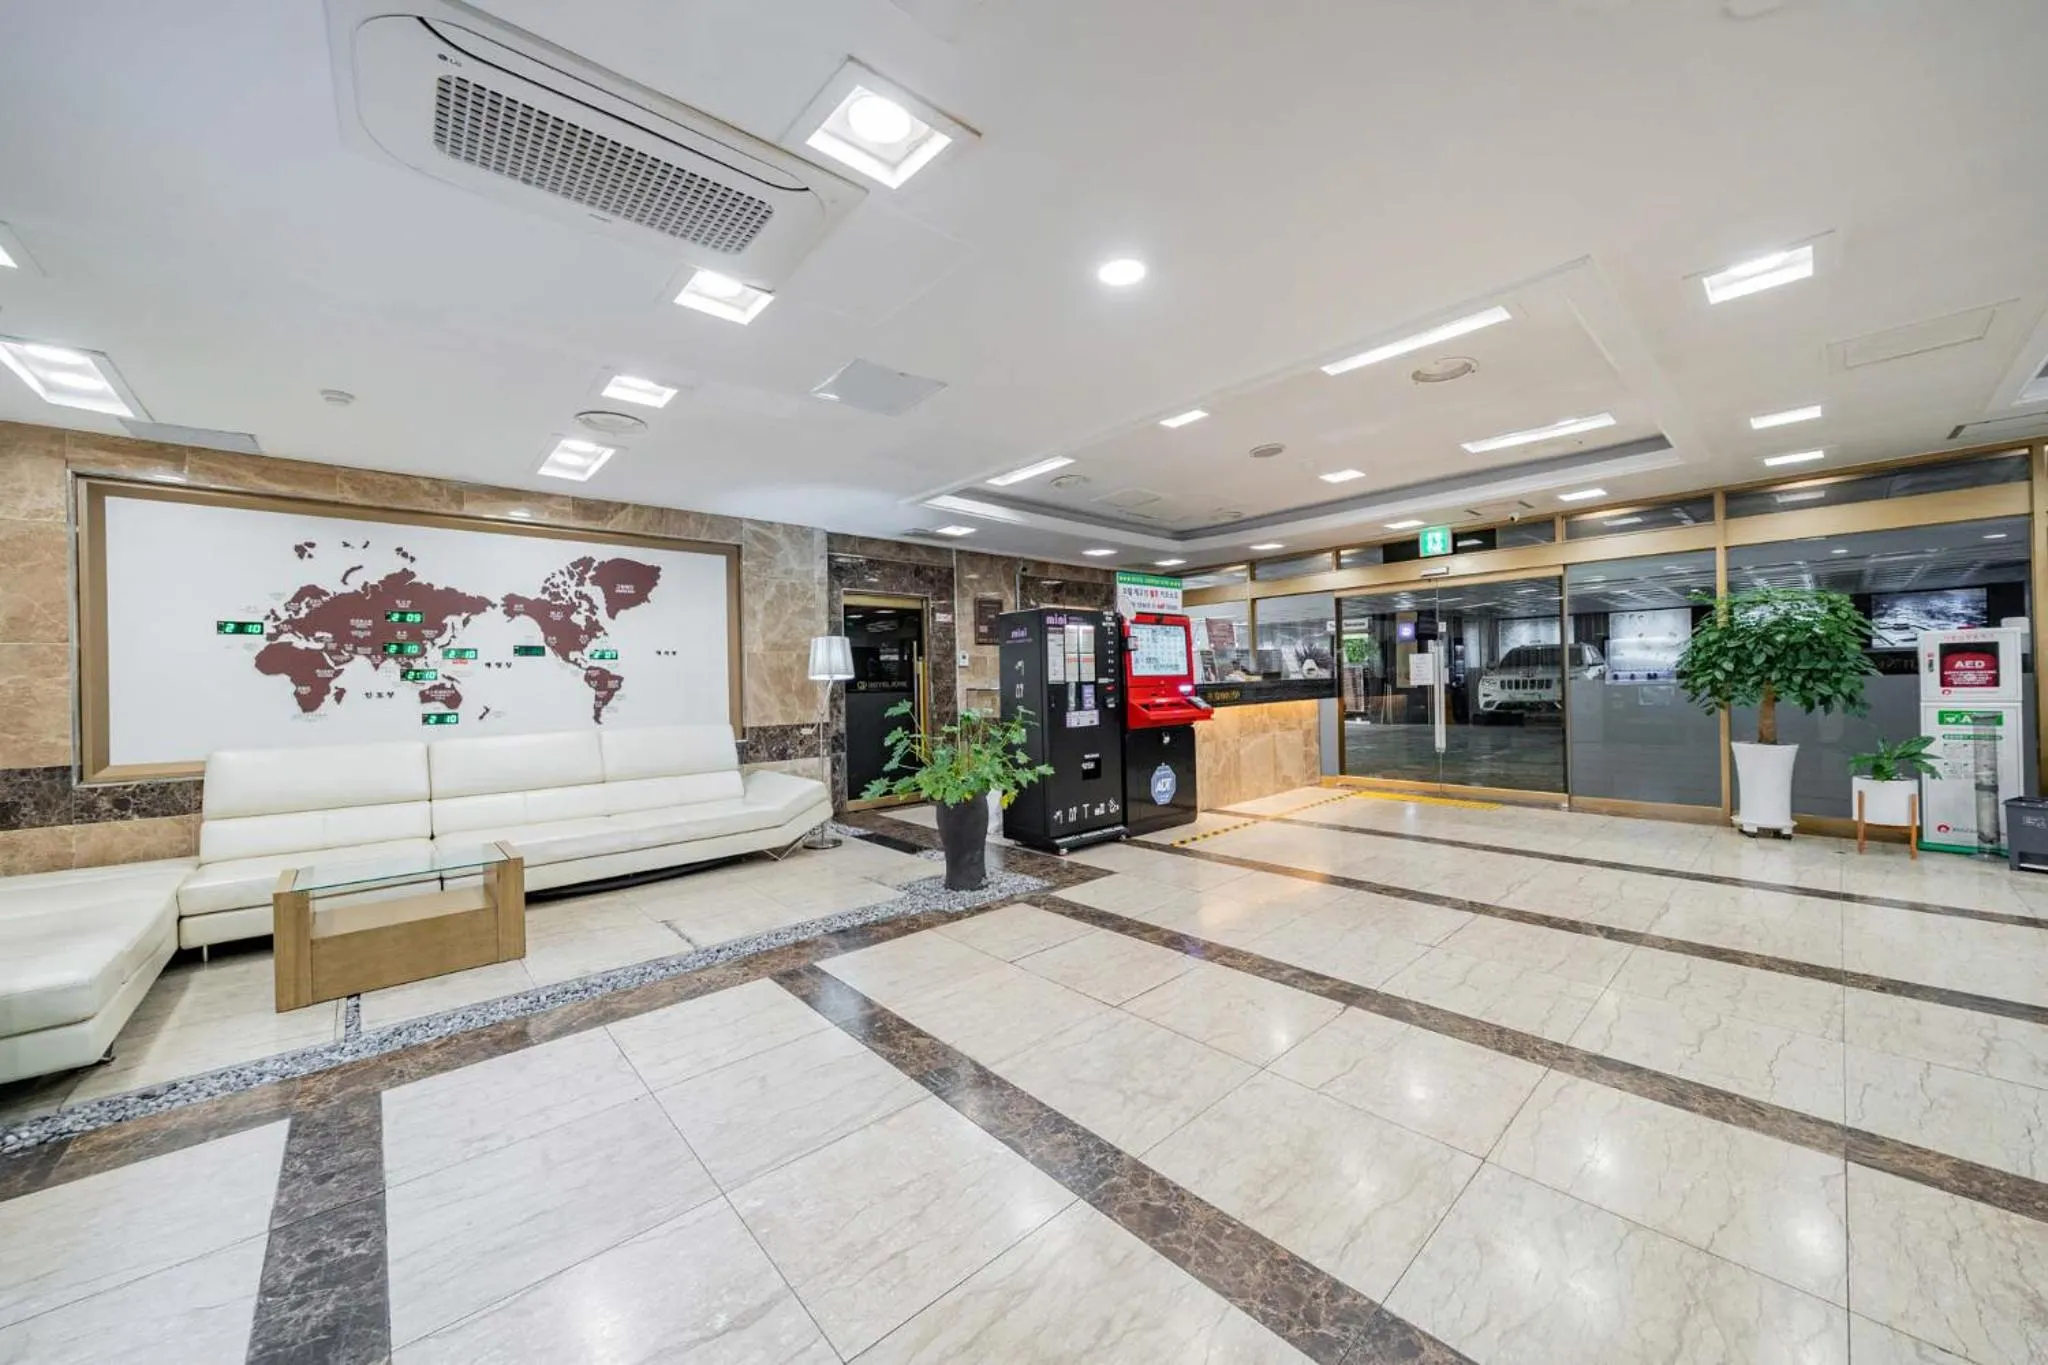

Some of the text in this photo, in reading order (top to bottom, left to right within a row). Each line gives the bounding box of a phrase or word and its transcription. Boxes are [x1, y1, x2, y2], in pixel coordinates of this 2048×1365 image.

[1046, 612, 1067, 625] mini
[1011, 628, 1028, 639] mini
[1955, 660, 1985, 669] AED
